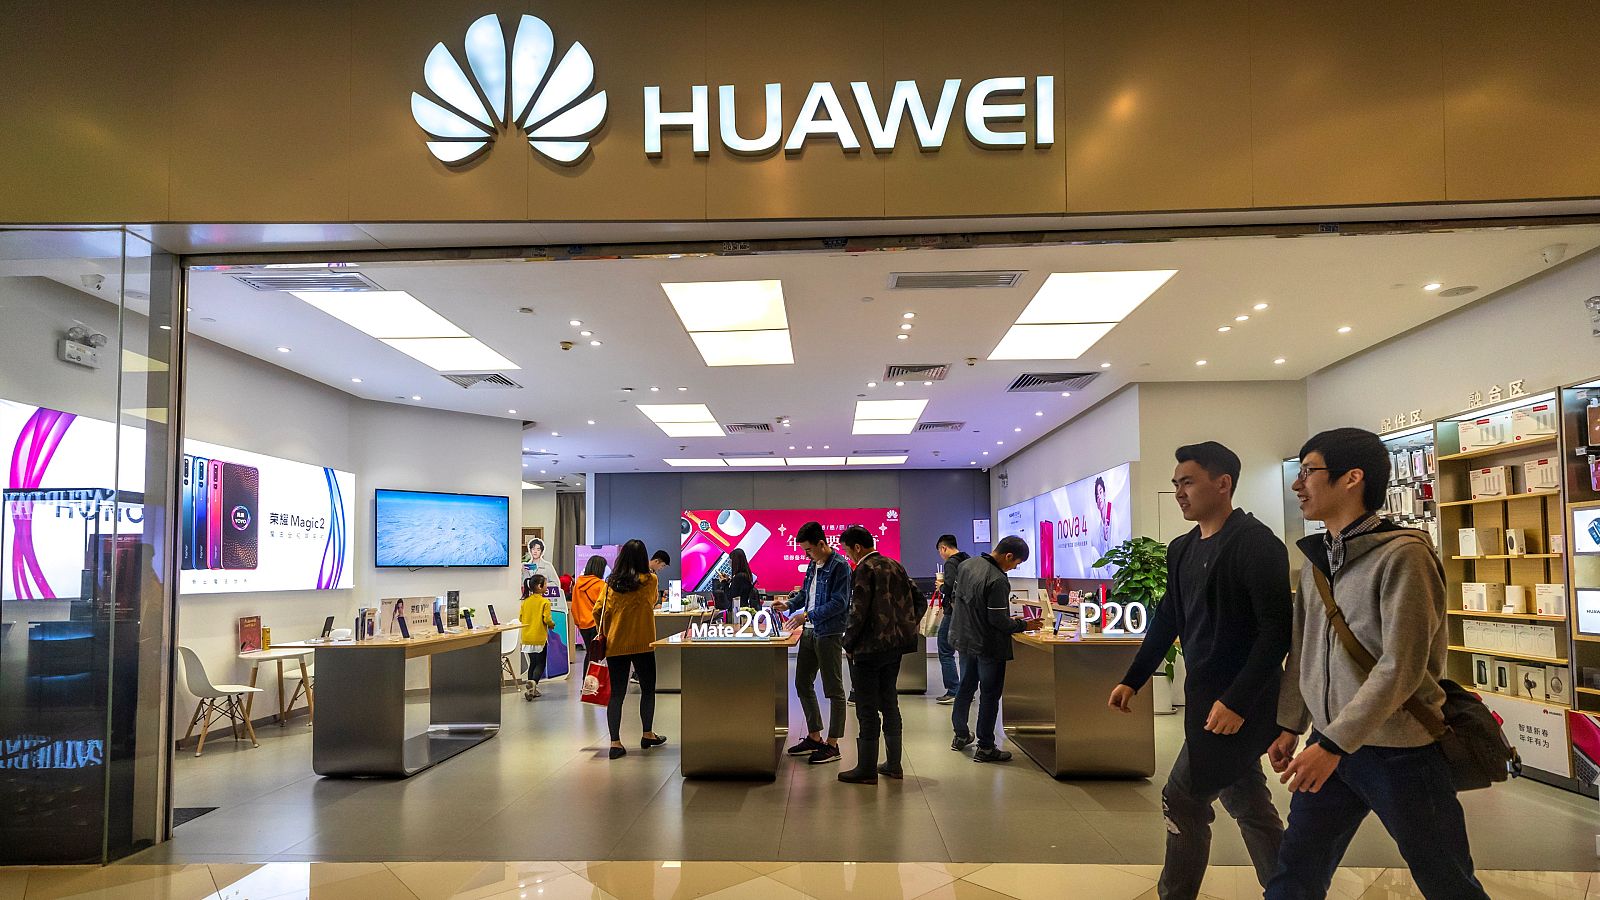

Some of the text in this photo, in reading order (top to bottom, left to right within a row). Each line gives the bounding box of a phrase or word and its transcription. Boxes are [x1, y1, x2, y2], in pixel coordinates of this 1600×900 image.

[644, 75, 1055, 156] HUAWEI
[1469, 379, 1530, 408] 融合区
[1382, 409, 1424, 432] 配件区
[1057, 514, 1088, 540] nova 4
[691, 610, 772, 638] Mate 20
[1079, 601, 1147, 634] P20
[1518, 723, 1549, 737] 智慧新春
[1519, 734, 1550, 749] 年年有为
